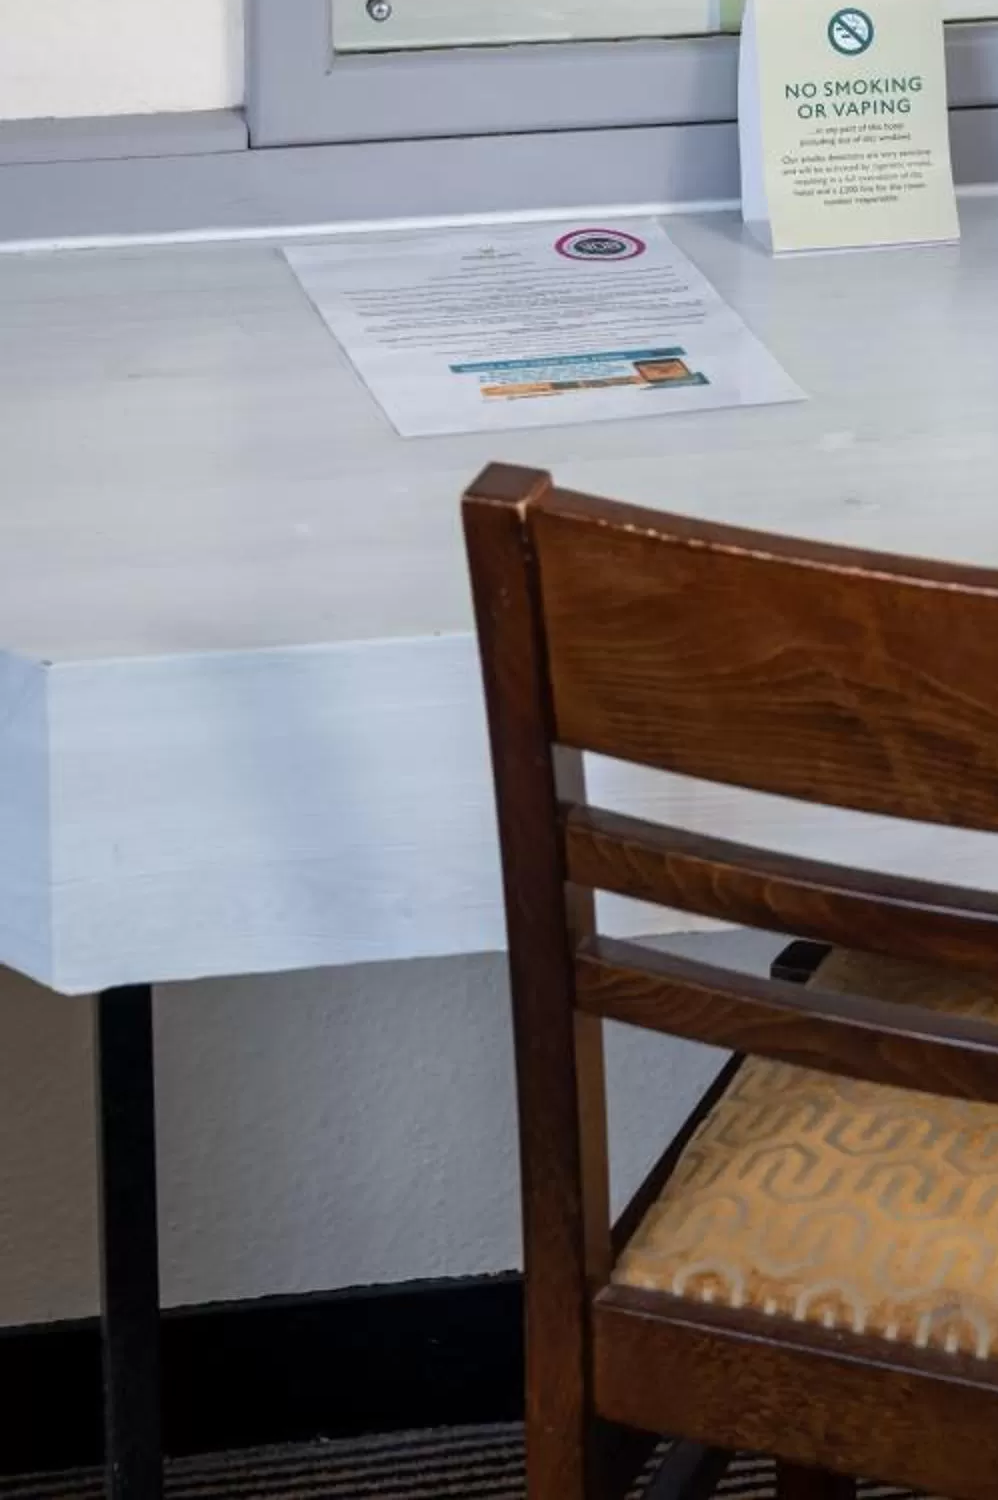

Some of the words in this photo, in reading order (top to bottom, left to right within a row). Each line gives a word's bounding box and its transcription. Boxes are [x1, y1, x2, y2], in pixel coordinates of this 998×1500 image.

[785, 83, 817, 100] NO
[823, 76, 923, 97] SMOKING
[797, 103, 827, 119] OR
[832, 98, 911, 117] VAPING
